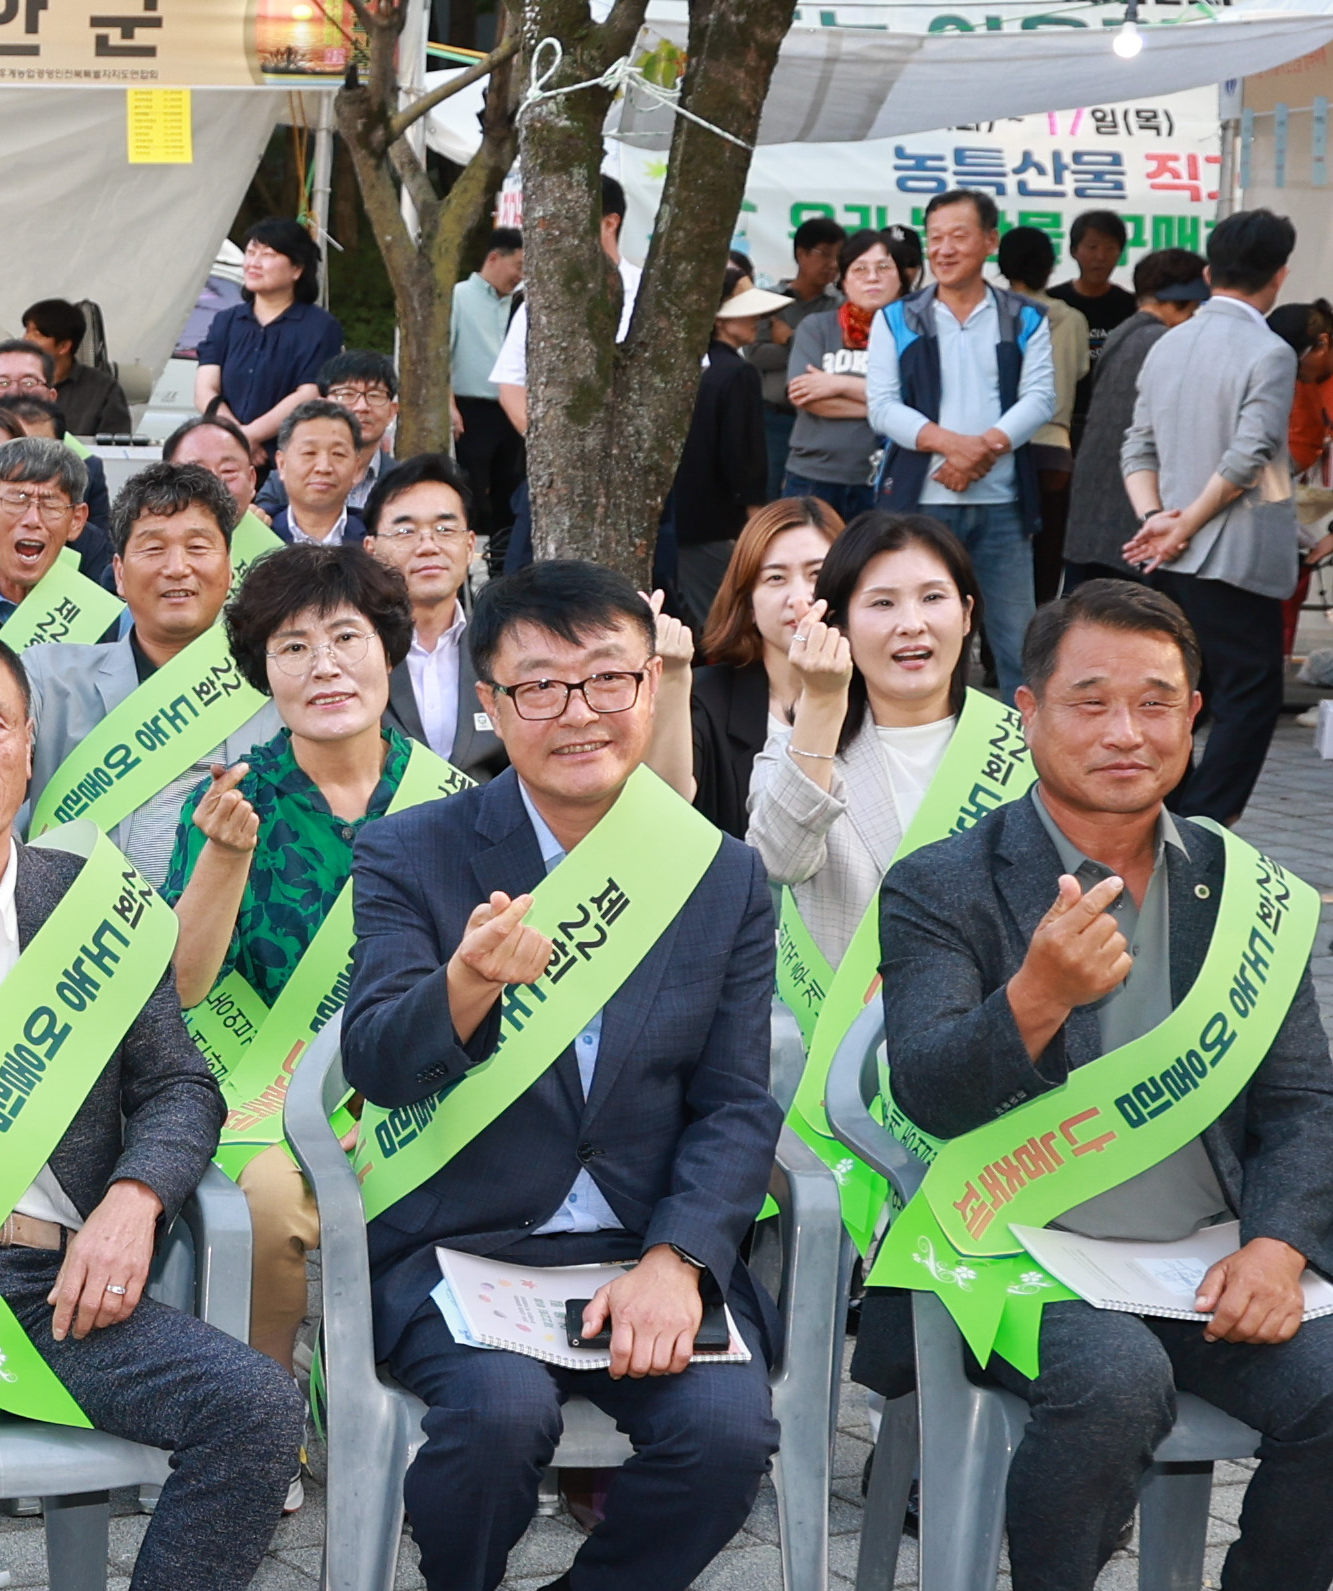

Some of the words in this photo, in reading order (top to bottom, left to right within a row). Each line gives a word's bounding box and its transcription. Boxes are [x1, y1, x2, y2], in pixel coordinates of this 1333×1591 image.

[893, 147, 1127, 200] 농특산물
[135, 694, 201, 753] 도농
[57, 917, 132, 1014] 도농
[1230, 925, 1277, 1017] 도농
[1113, 1010, 1239, 1130] 어울림
[952, 1104, 1119, 1242] 나눔축제
